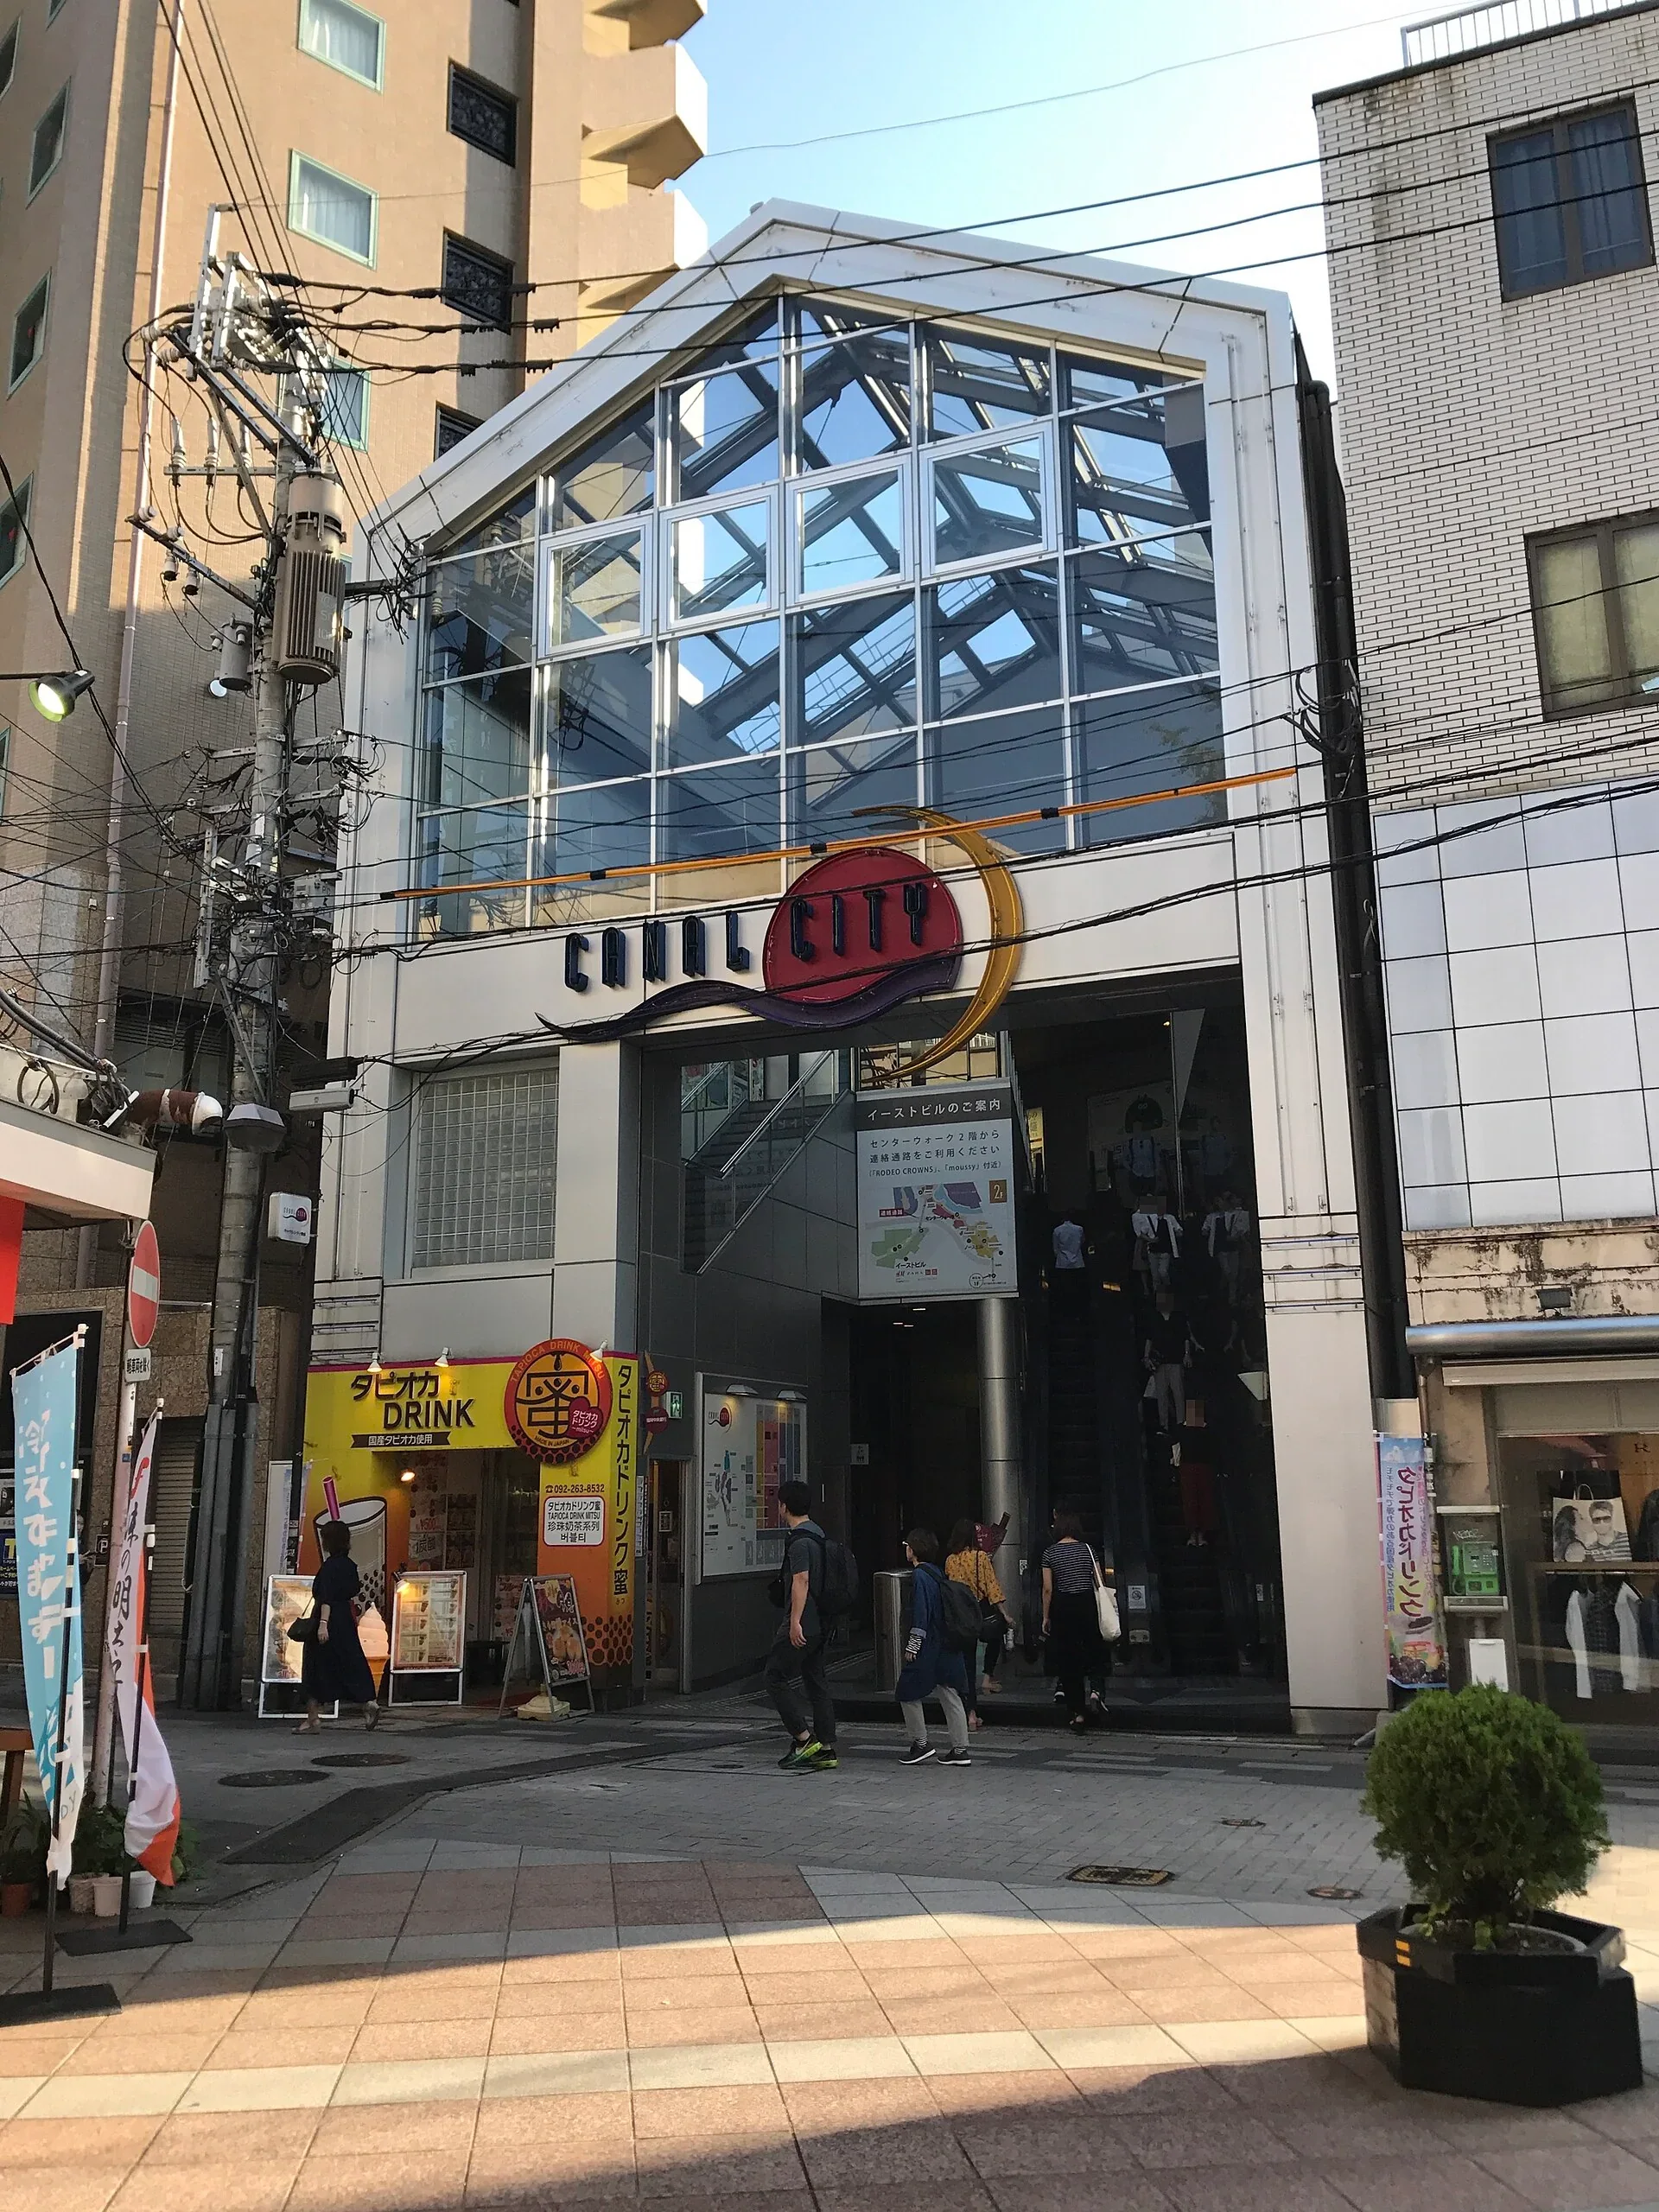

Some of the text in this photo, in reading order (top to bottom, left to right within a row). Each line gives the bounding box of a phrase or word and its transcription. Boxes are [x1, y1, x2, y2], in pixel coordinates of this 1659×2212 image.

[564, 881, 929, 993] CANAL CITY
[868, 1099, 1001, 1121] イーストビルのご案内
[869, 1146, 1001, 1164] 連絡通路をご利用ください
[994, 1184, 1003, 1199] 2F
[511, 1341, 606, 1382] TAPIOCA DRINK MITSU
[351, 1370, 441, 1402] タピオカ
[383, 1399, 475, 1431] DRINK
[573, 1409, 599, 1421] タピオカ
[572, 1418, 598, 1428] ドリンク
[368, 1433, 433, 1446] 国産タピオカ使用
[534, 1434, 548, 1446] MADE
[613, 1363, 632, 1596] タピオカドリンク蜜
[554, 1484, 605, 1493] 092-263-8532
[548, 1500, 601, 1511] タピオカドリンク蜜
[548, 1511, 601, 1520] TAPIOCA DRINK MITSU
[548, 1521, 601, 1532] 珍珠奶茶系列
[560, 1532, 587, 1543] 버블티
